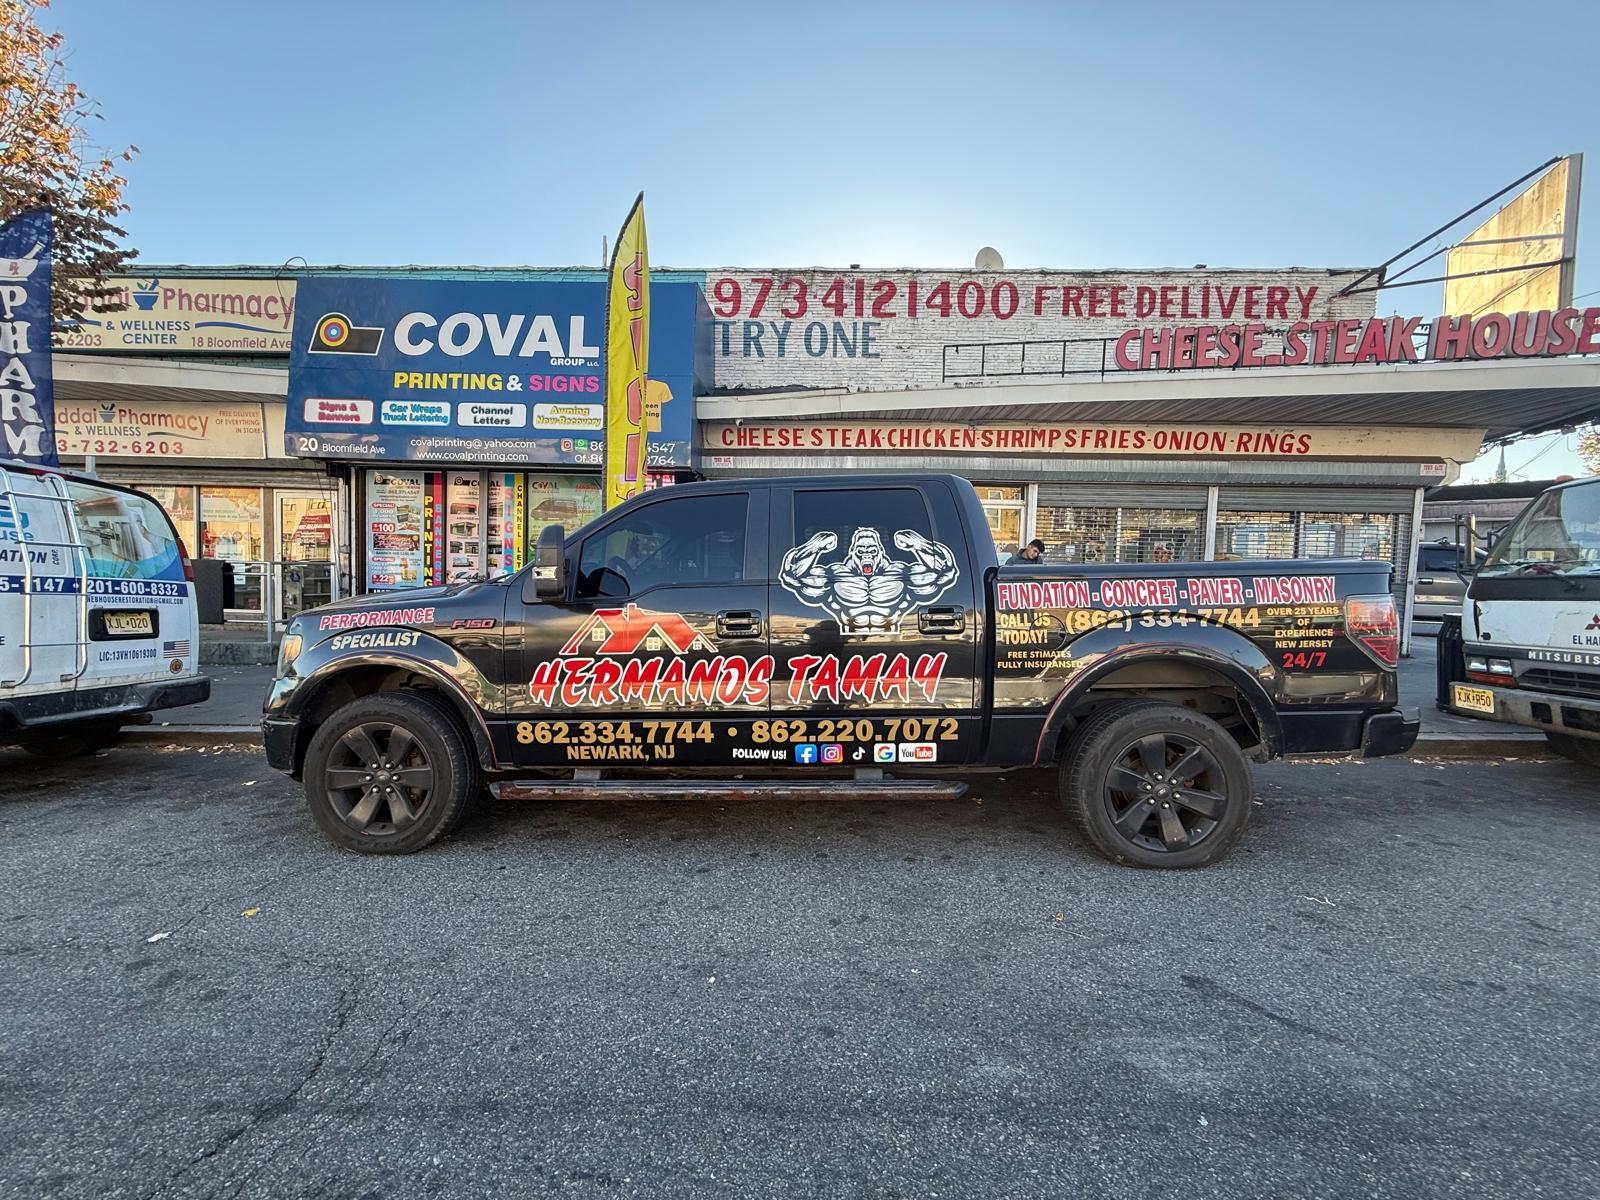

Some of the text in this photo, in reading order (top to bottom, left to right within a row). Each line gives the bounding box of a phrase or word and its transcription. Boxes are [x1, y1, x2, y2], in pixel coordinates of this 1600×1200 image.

[163, 288, 295, 330] Pharmacy
[1033, 285, 1127, 317] FREE
[1135, 285, 1319, 320] DELIVERY
[106, 320, 191, 331] & WELLNESS
[122, 333, 177, 345] CENTER
[191, 336, 292, 349] 18 Bloomfield Ave
[394, 311, 600, 358] COVAL
[714, 320, 881, 359] TRY ONE
[1114, 306, 1600, 371] CHEESE STEAK HOUSE
[551, 358, 585, 366] GROUP
[394, 372, 600, 393] PRINTING & SIGNS
[318, 402, 347, 412] Signs
[411, 403, 442, 414] Wraps
[471, 406, 513, 415] Channel
[550, 405, 590, 416] Awning
[54, 407, 209, 437] ddai Pharmacy
[318, 412, 361, 422] Banners
[383, 412, 449, 424] Truck Lettering
[473, 416, 511, 425] Letters
[74, 426, 141, 437] & WELLNESS
[299, 437, 386, 454] 20 Bloomfield Ave
[721, 427, 804, 448] CHEESE
[810, 428, 882, 448] STEAK
[887, 428, 977, 449] CHICKEN
[1080, 429, 1146, 450] FRIES
[1153, 430, 1227, 452] ONION
[1236, 432, 1312, 454] RINGS
[417, 451, 529, 462] www.covalprinting.com
[504, 488, 514, 567] SIGNS
[424, 496, 433, 587] PRINTING
[86, 580, 179, 596] 201-600-8332
[997, 576, 1336, 609] FUNDATION CONCRET PAVER MASONRY
[319, 607, 435, 630] PERFORMANCE
[1308, 607, 1339, 615] YEARS
[1000, 612, 1051, 628] CALL US
[1066, 608, 1261, 634] (862) 334-7744
[1297, 618, 1310, 626] OF
[330, 631, 422, 650] SPECIALIST
[1005, 629, 1048, 645] TODAY!
[1275, 629, 1333, 637] EXPERIENCE
[1572, 635, 1583, 645] EL
[1298, 640, 1333, 648] JERSEY
[1008, 650, 1071, 659] FREE STIMATES
[1282, 652, 1327, 668] 24/7
[997, 661, 1023, 669] FULLY
[529, 652, 948, 707] HERMANOS TAMAY
[516, 719, 959, 744] 862.334.7744 862.220.7072
[566, 745, 675, 761] NEWARK, NJ
[732, 748, 770, 759] FOLLOW
[772, 749, 787, 760] US!
[901, 746, 934, 760] YouTube
